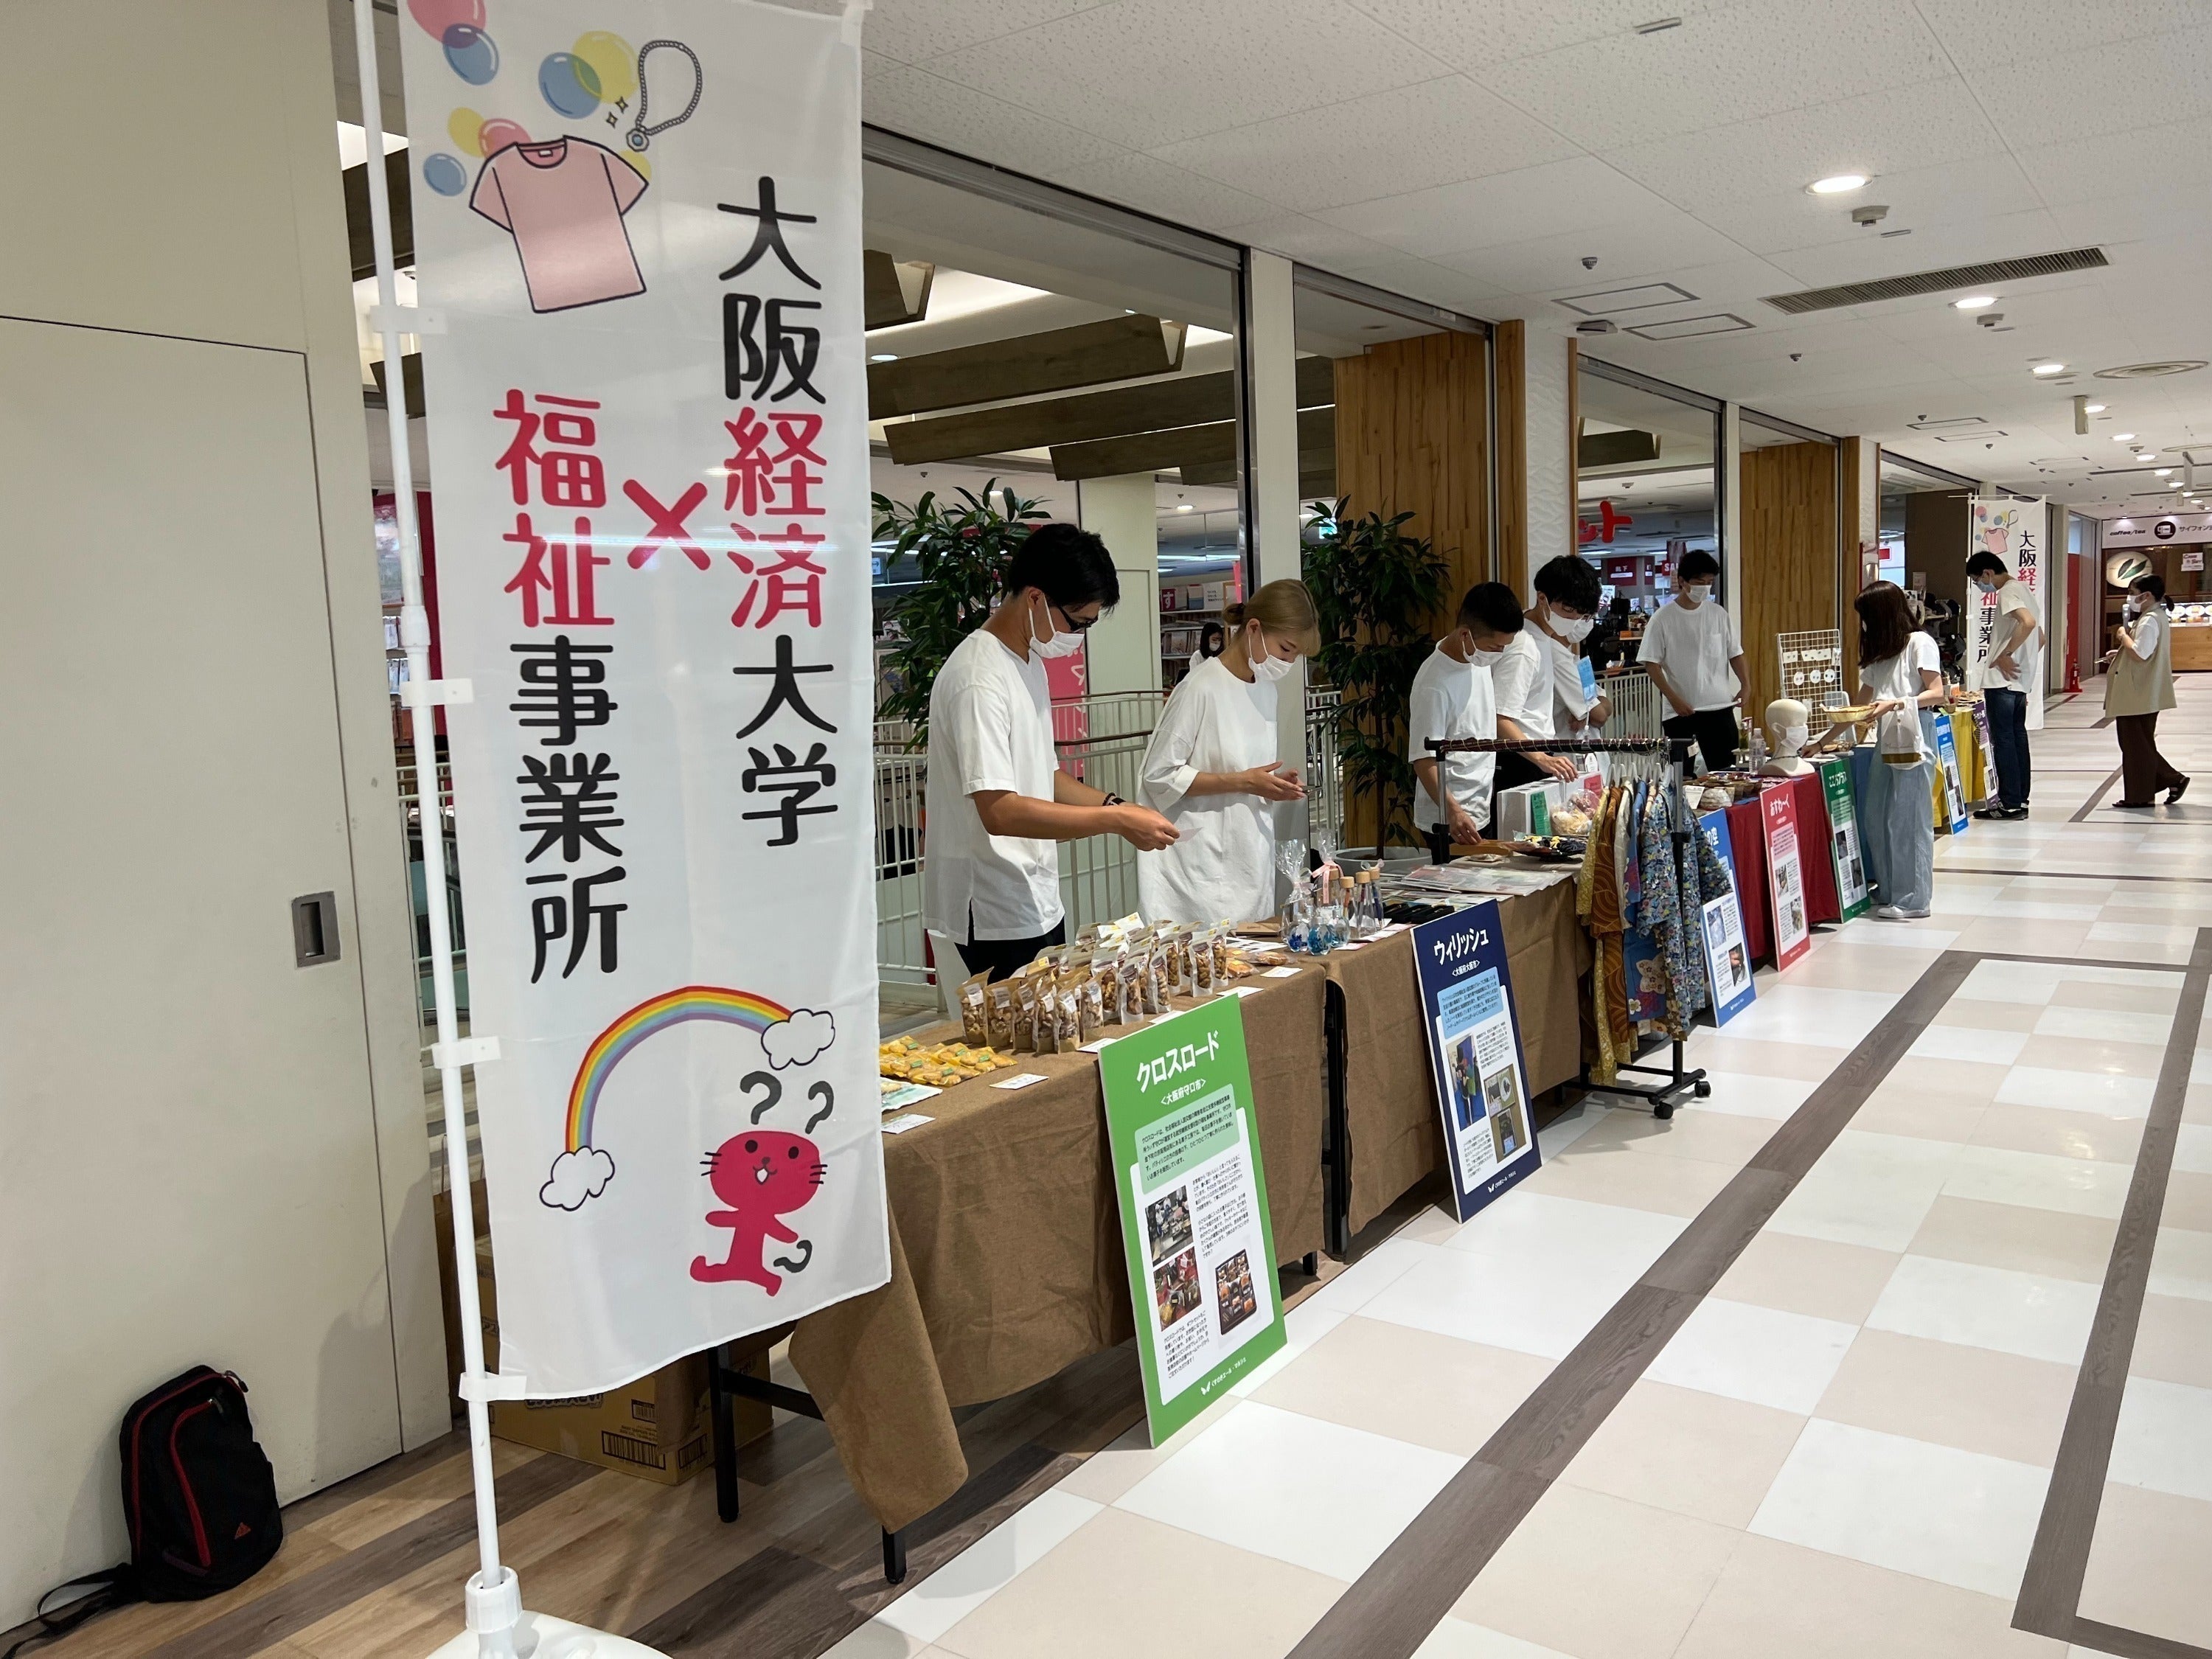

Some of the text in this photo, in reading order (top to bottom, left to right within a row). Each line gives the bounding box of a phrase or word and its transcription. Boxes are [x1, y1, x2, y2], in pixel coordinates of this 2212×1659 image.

[717, 175, 838, 847] 大阪経済大学
[494, 389, 627, 985] 福祉事業所
[1135, 1029, 1220, 1094] クロスロード
[1433, 927, 1489, 966] ウィリッシュ
